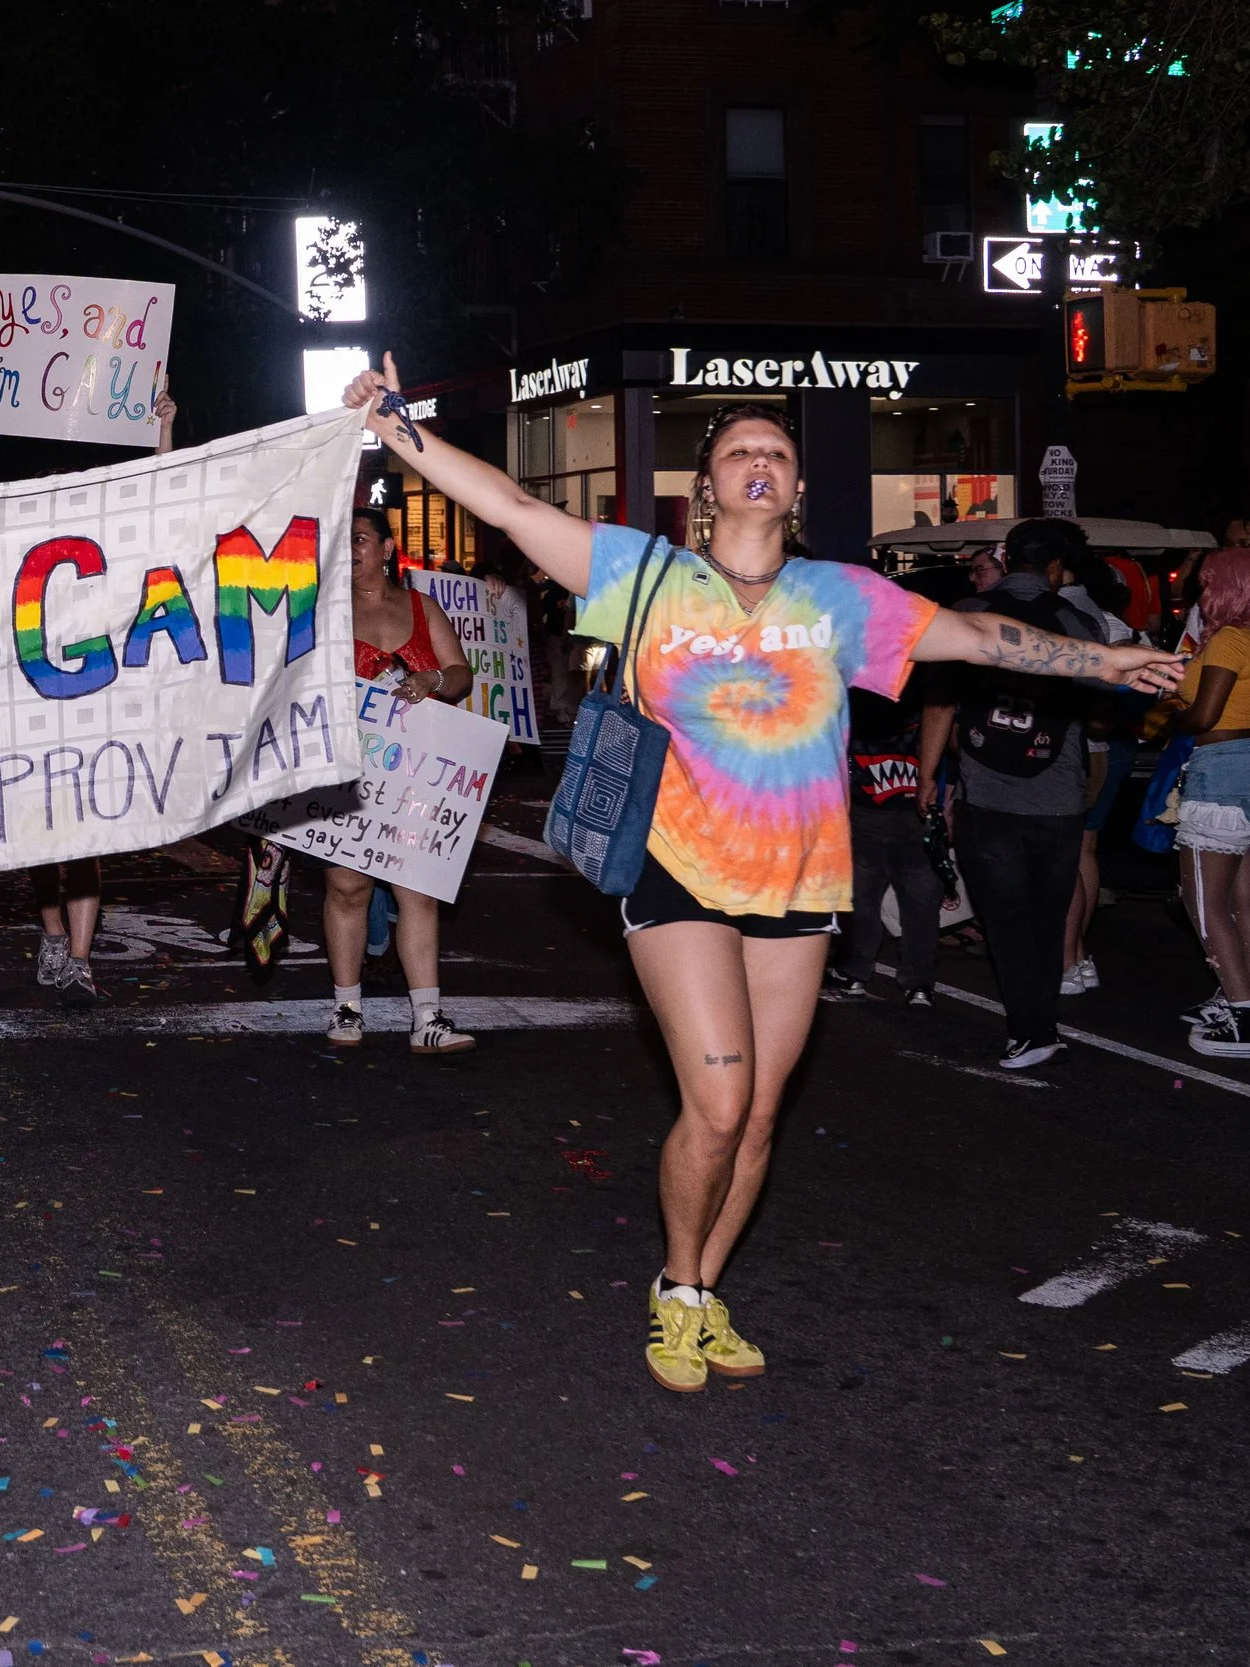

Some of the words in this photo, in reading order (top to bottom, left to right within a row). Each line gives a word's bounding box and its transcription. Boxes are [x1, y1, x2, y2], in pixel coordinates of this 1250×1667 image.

[1015, 256, 1043, 276] ON
[83, 296, 158, 351] and
[509, 357, 590, 403] LaserAway
[670, 347, 920, 399] LaserAway
[13, 515, 320, 701] GAM
[429, 577, 479, 612] AUGH
[451, 616, 486, 642] UGH
[660, 626, 744, 663] yes,
[760, 615, 833, 652] and
[467, 648, 506, 680] UGH
[206, 694, 335, 801] JAM
[427, 756, 489, 802] JAM
[306, 801, 373, 842] every
[391, 786, 468, 839] friday
